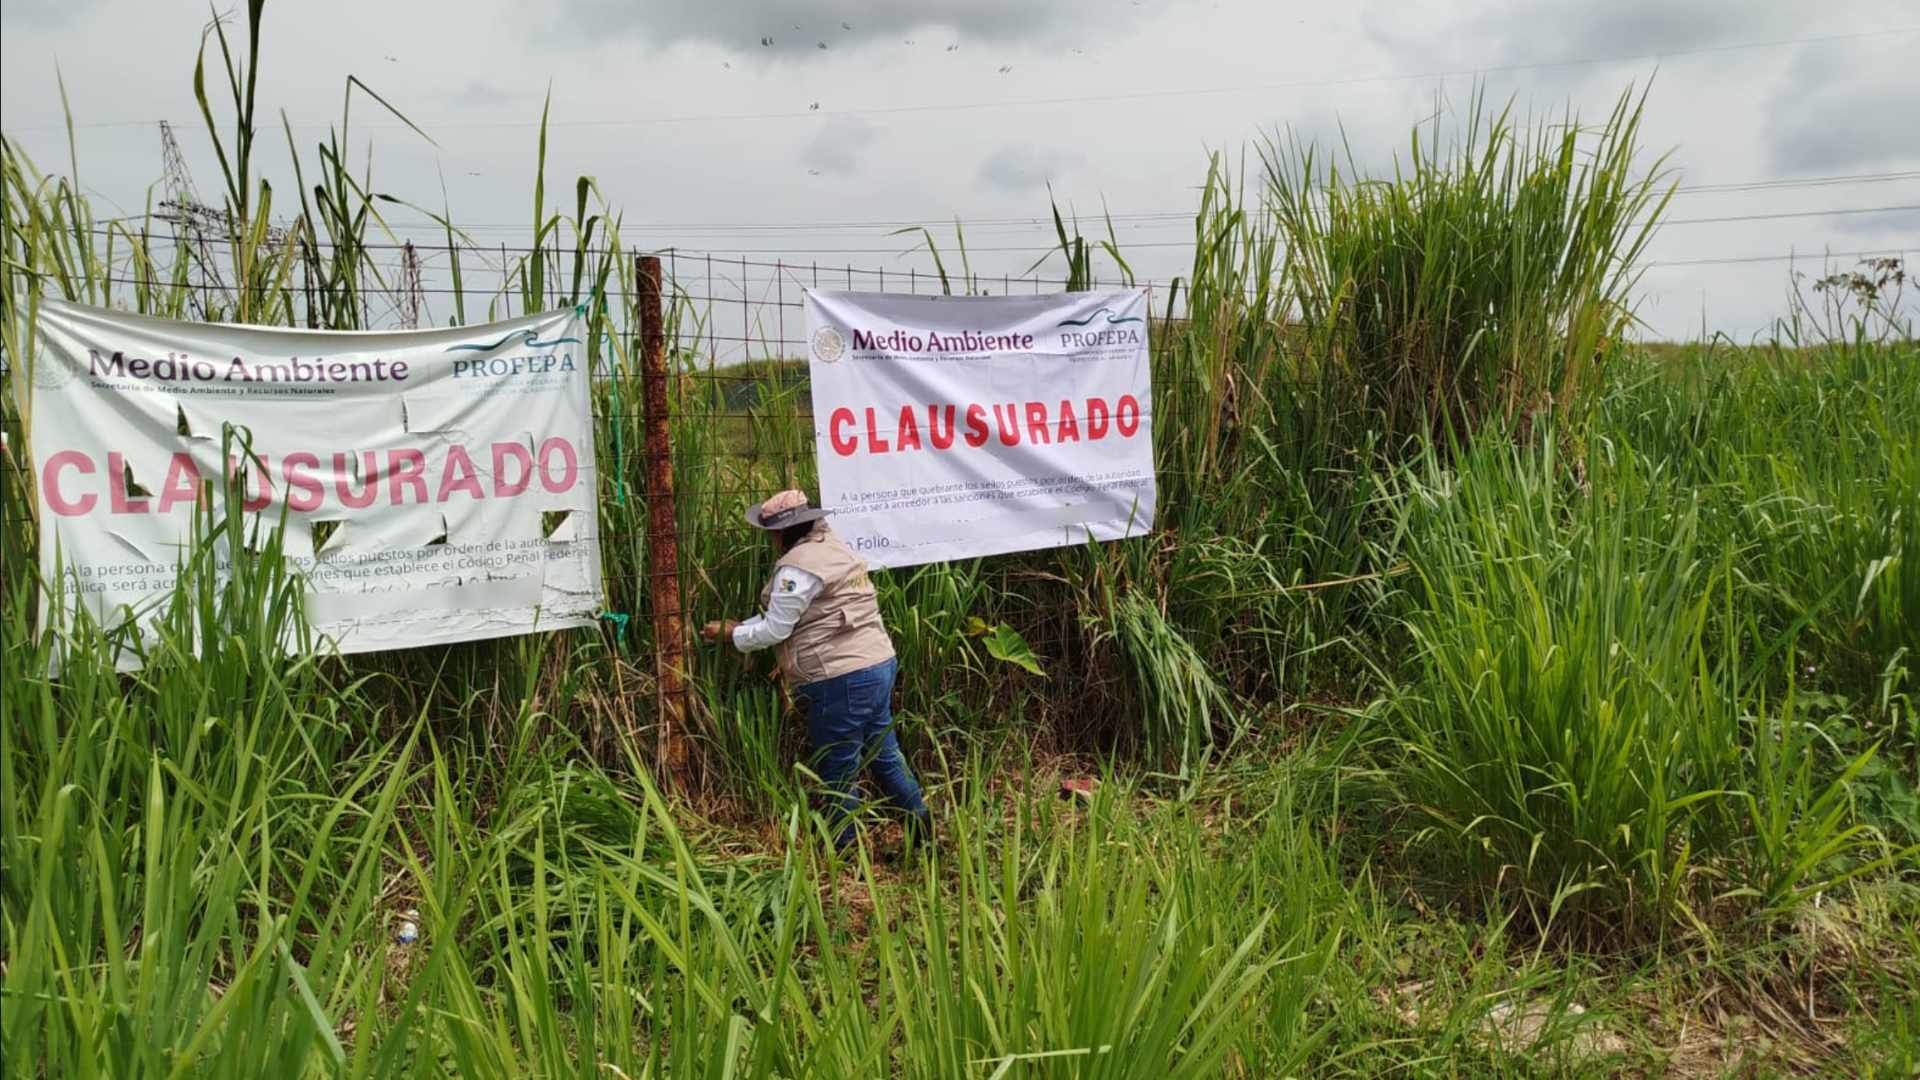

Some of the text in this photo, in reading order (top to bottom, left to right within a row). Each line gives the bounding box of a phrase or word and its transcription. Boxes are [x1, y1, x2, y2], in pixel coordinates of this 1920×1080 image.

[852, 329, 1034, 351] Medio Ambiente
[1060, 329, 1140, 348] PROFEPA
[88, 350, 409, 382] Medio Ambiente
[453, 353, 576, 378] PROFEPA
[157, 385, 188, 394] Medio
[190, 386, 237, 395] Ambiente
[829, 394, 1140, 457] CLAUSURADO
[861, 490, 898, 502] persona
[900, 487, 915, 498] que
[358, 545, 414, 566] puestos
[416, 547, 442, 561] por
[443, 542, 483, 556] orden
[486, 540, 502, 552] de
[504, 538, 516, 550] la
[857, 537, 890, 550] Folio
[79, 562, 93, 577] la
[97, 560, 165, 580] persona
[344, 567, 371, 581] que
[374, 560, 440, 577] establece
[112, 577, 147, 593] será
